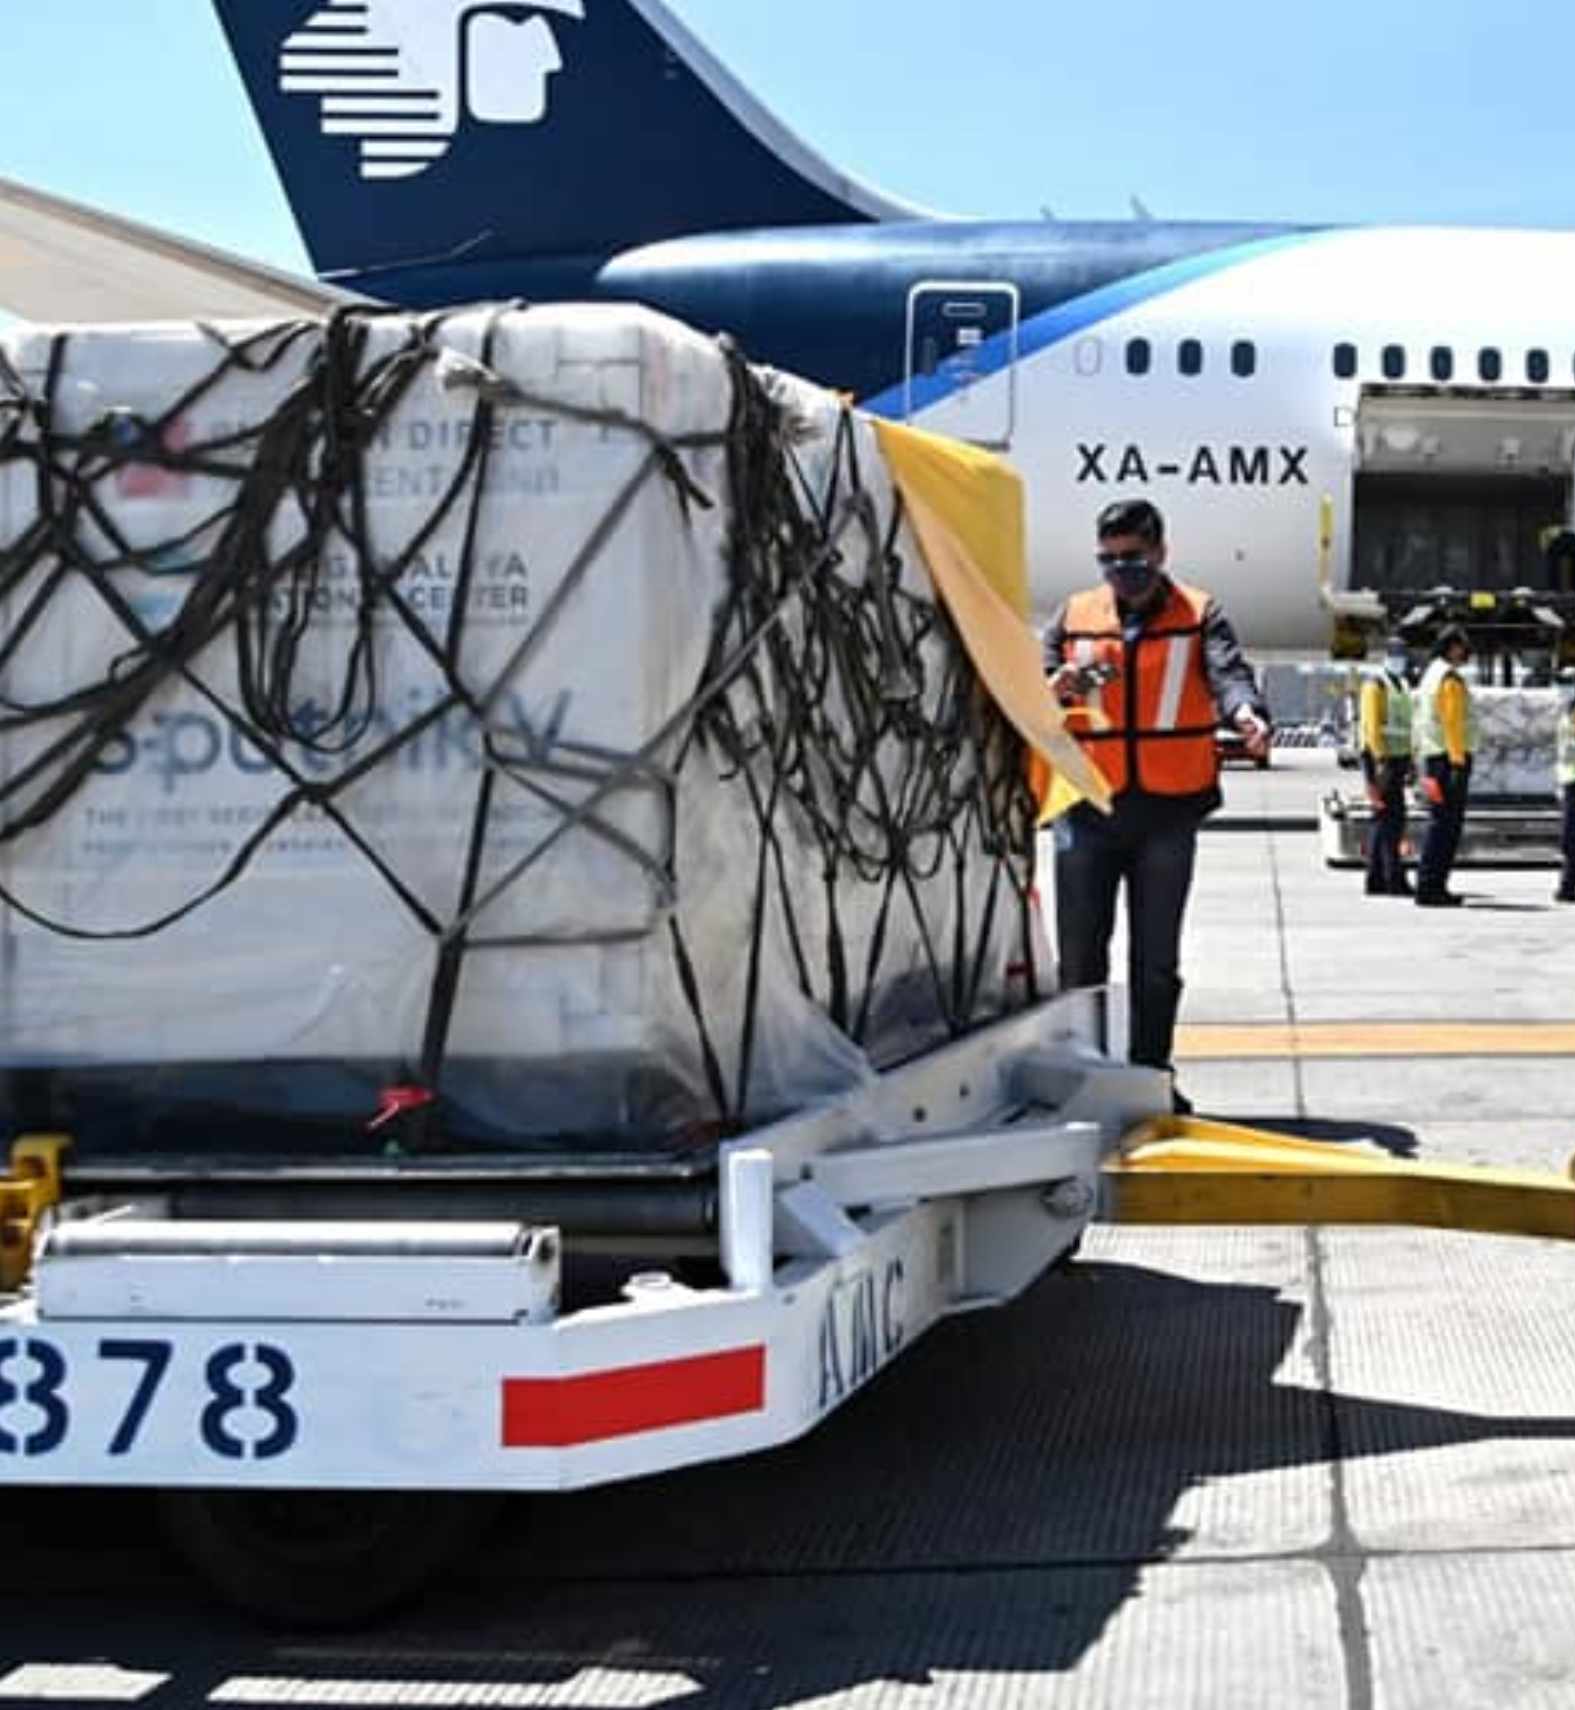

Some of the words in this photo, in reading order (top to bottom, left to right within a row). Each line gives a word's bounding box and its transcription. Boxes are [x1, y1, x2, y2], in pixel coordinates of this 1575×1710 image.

[1076, 444, 1309, 484] XA-AMX
[408, 584, 529, 607] CETER
[0, 1338, 300, 1460] 878
